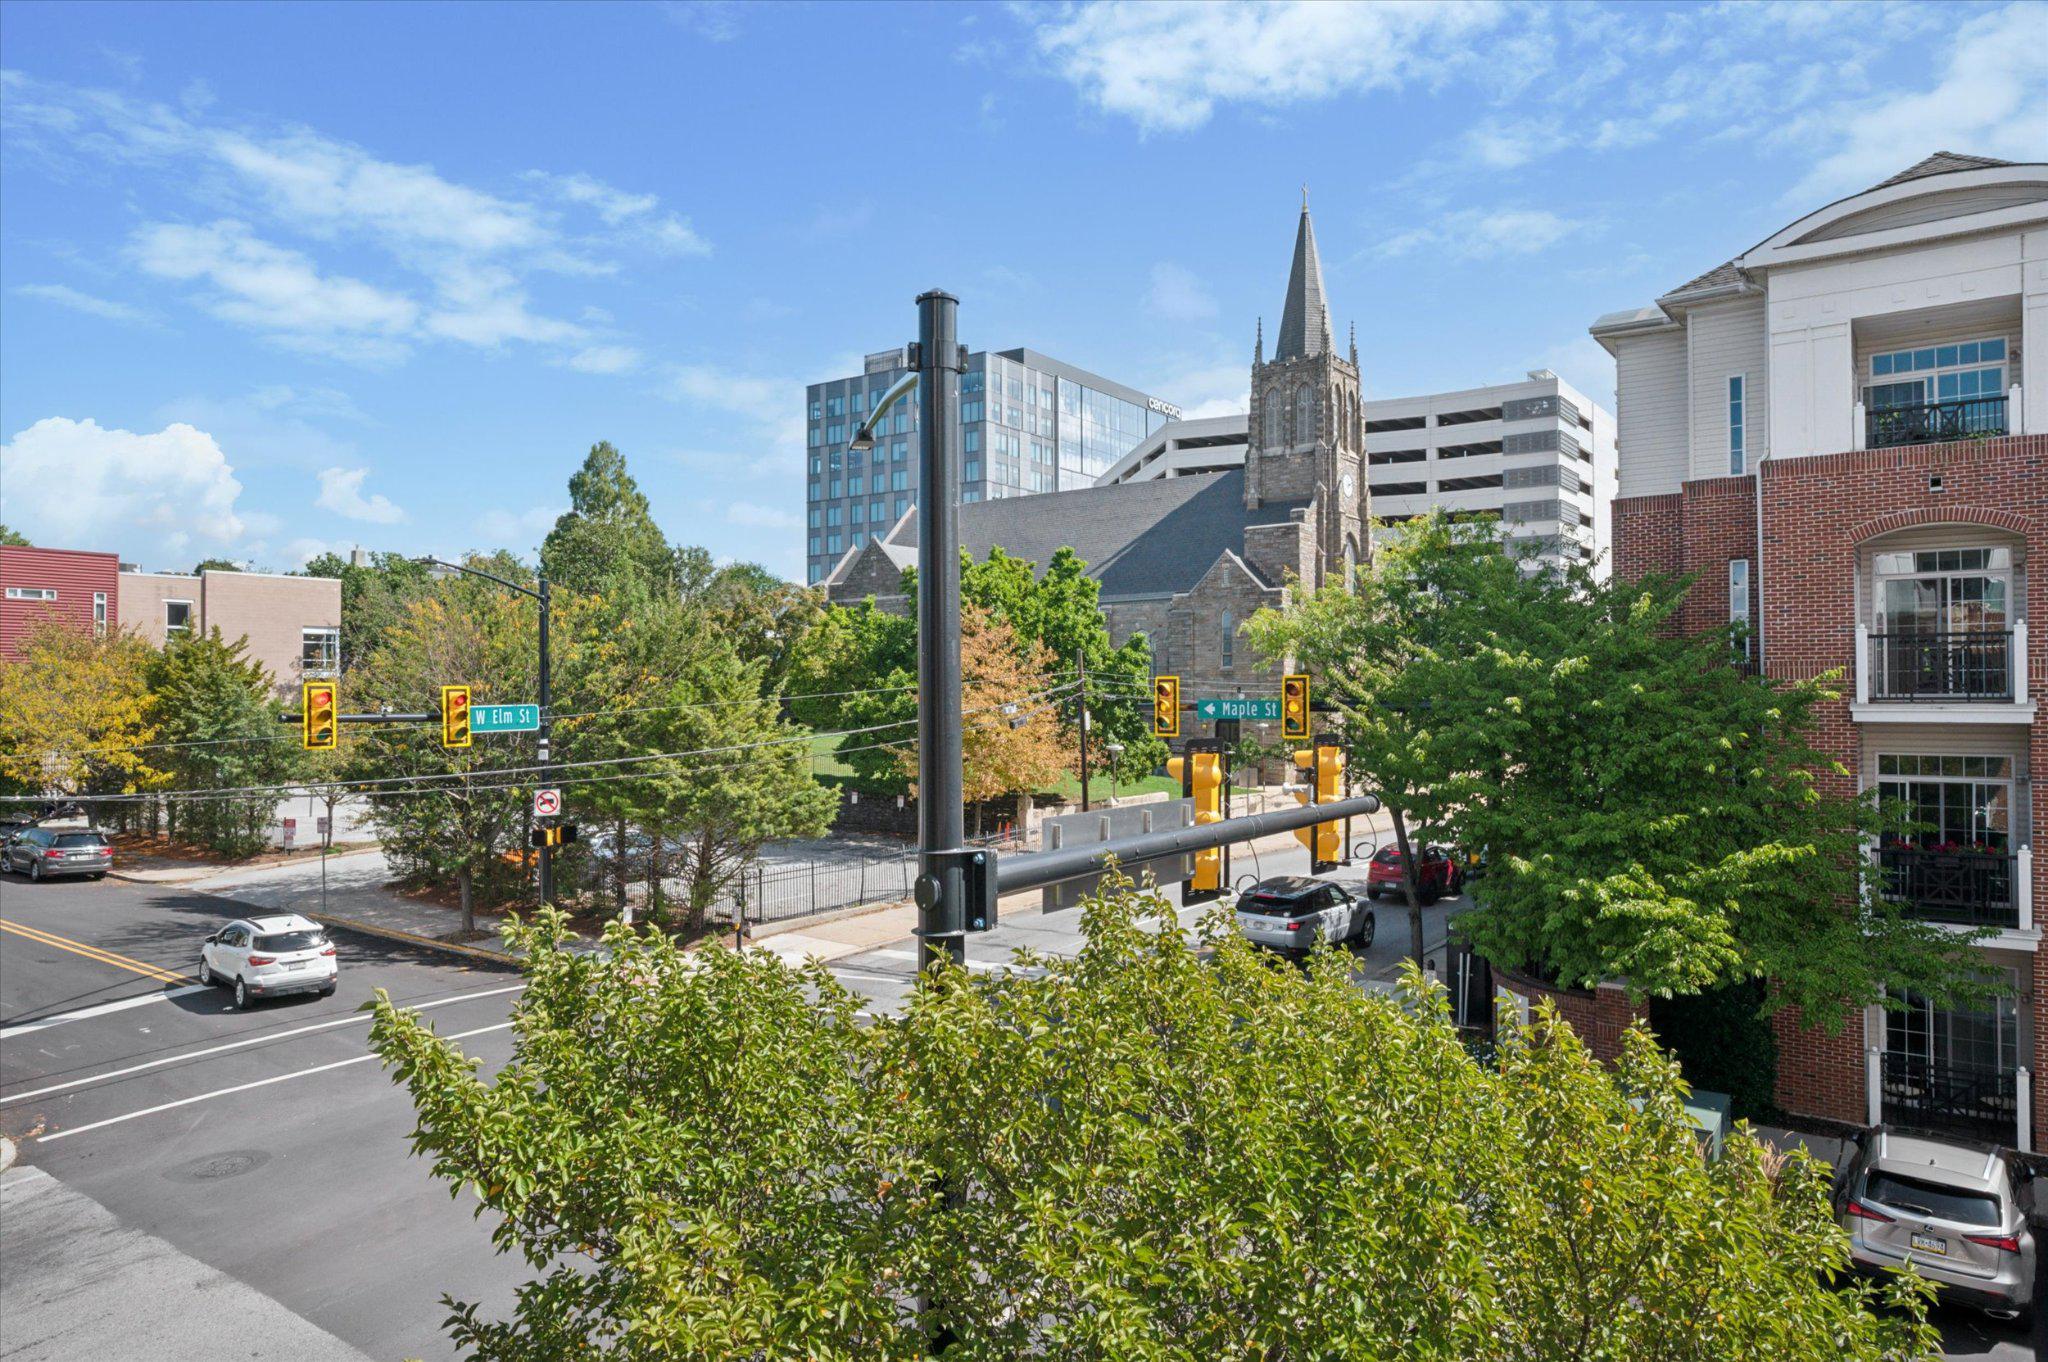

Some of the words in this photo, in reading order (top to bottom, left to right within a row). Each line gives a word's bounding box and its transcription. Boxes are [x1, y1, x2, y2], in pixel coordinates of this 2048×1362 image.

[475, 709, 486, 725] W
[492, 708, 513, 724] Elm
[519, 708, 530, 723] St
[1222, 701, 1258, 718] Maple
[1265, 702, 1277, 717] St
